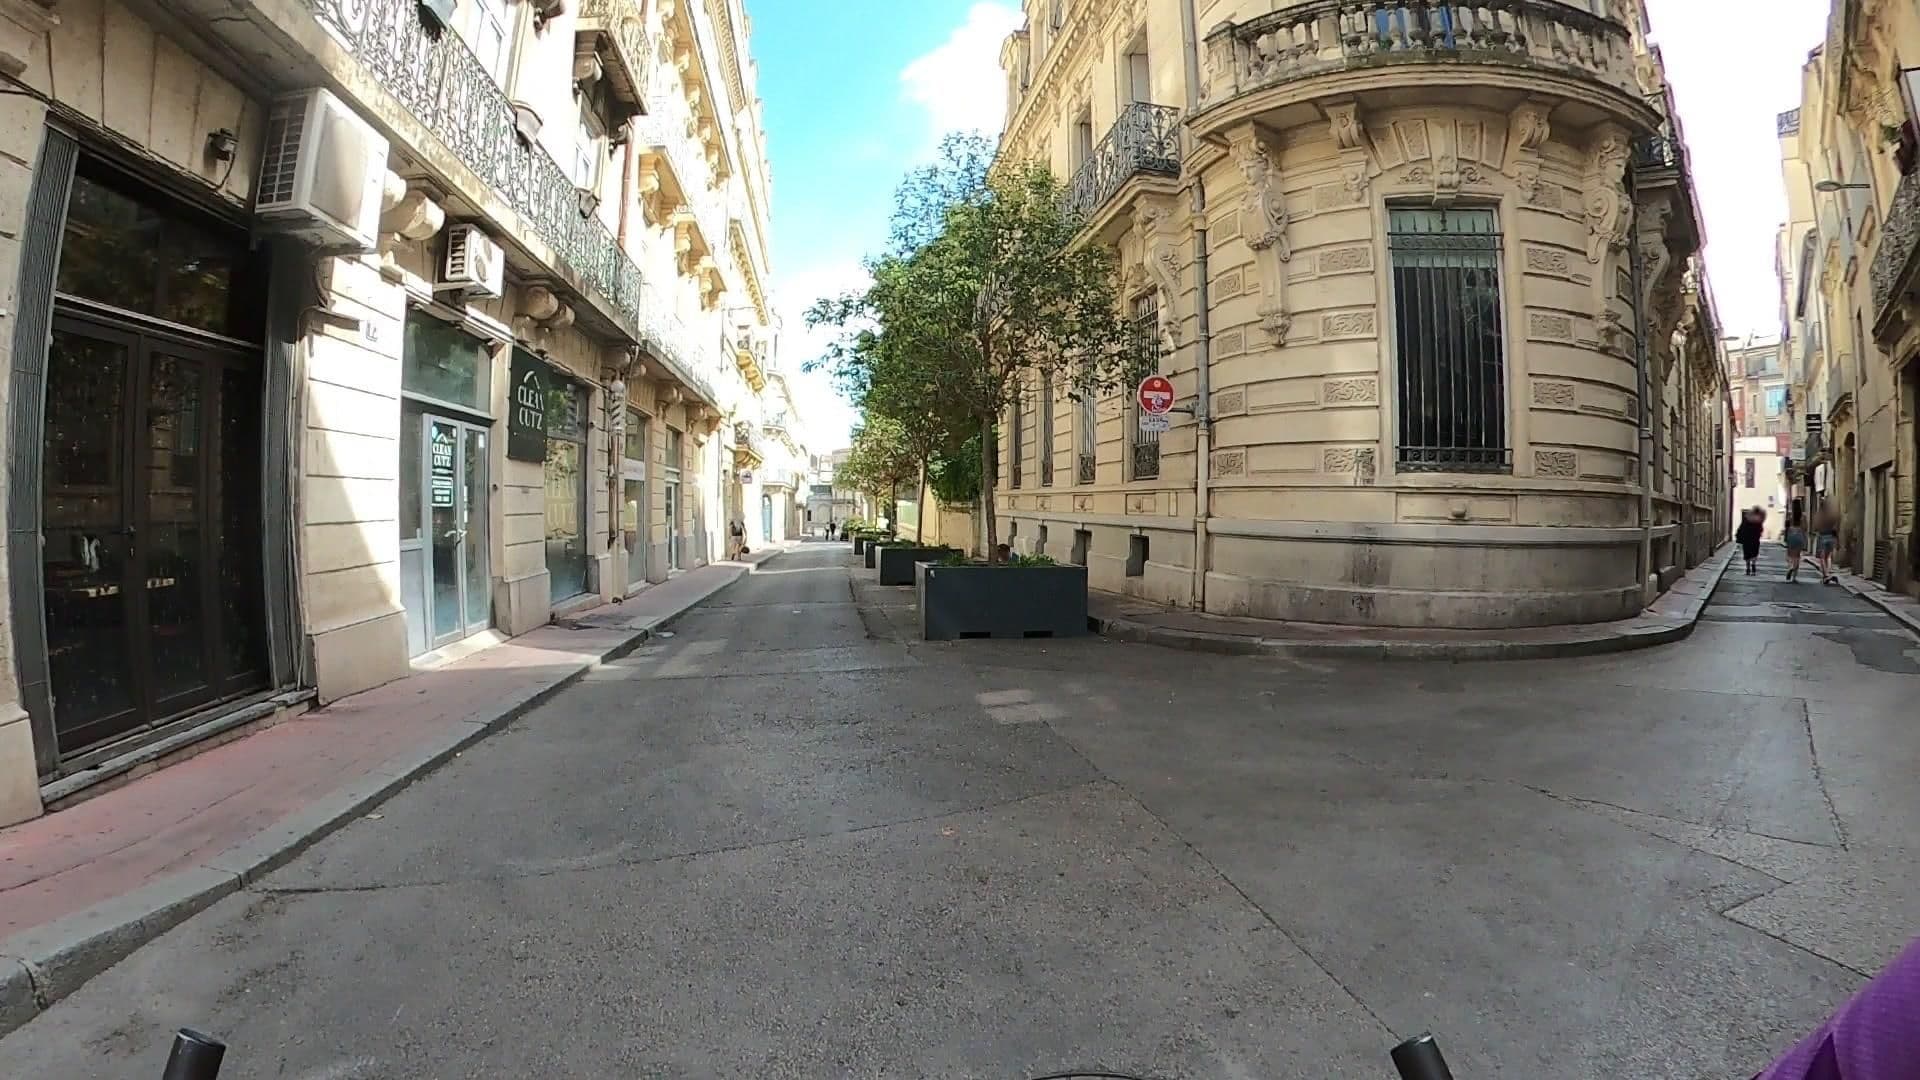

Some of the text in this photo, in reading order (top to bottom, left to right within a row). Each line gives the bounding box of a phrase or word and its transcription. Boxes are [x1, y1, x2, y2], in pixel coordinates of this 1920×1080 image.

[518, 385, 544, 411] CLEAN
[519, 407, 542, 430] CUTZ
[432, 442, 452, 456] CLEAN
[433, 455, 451, 467] CUTZ
